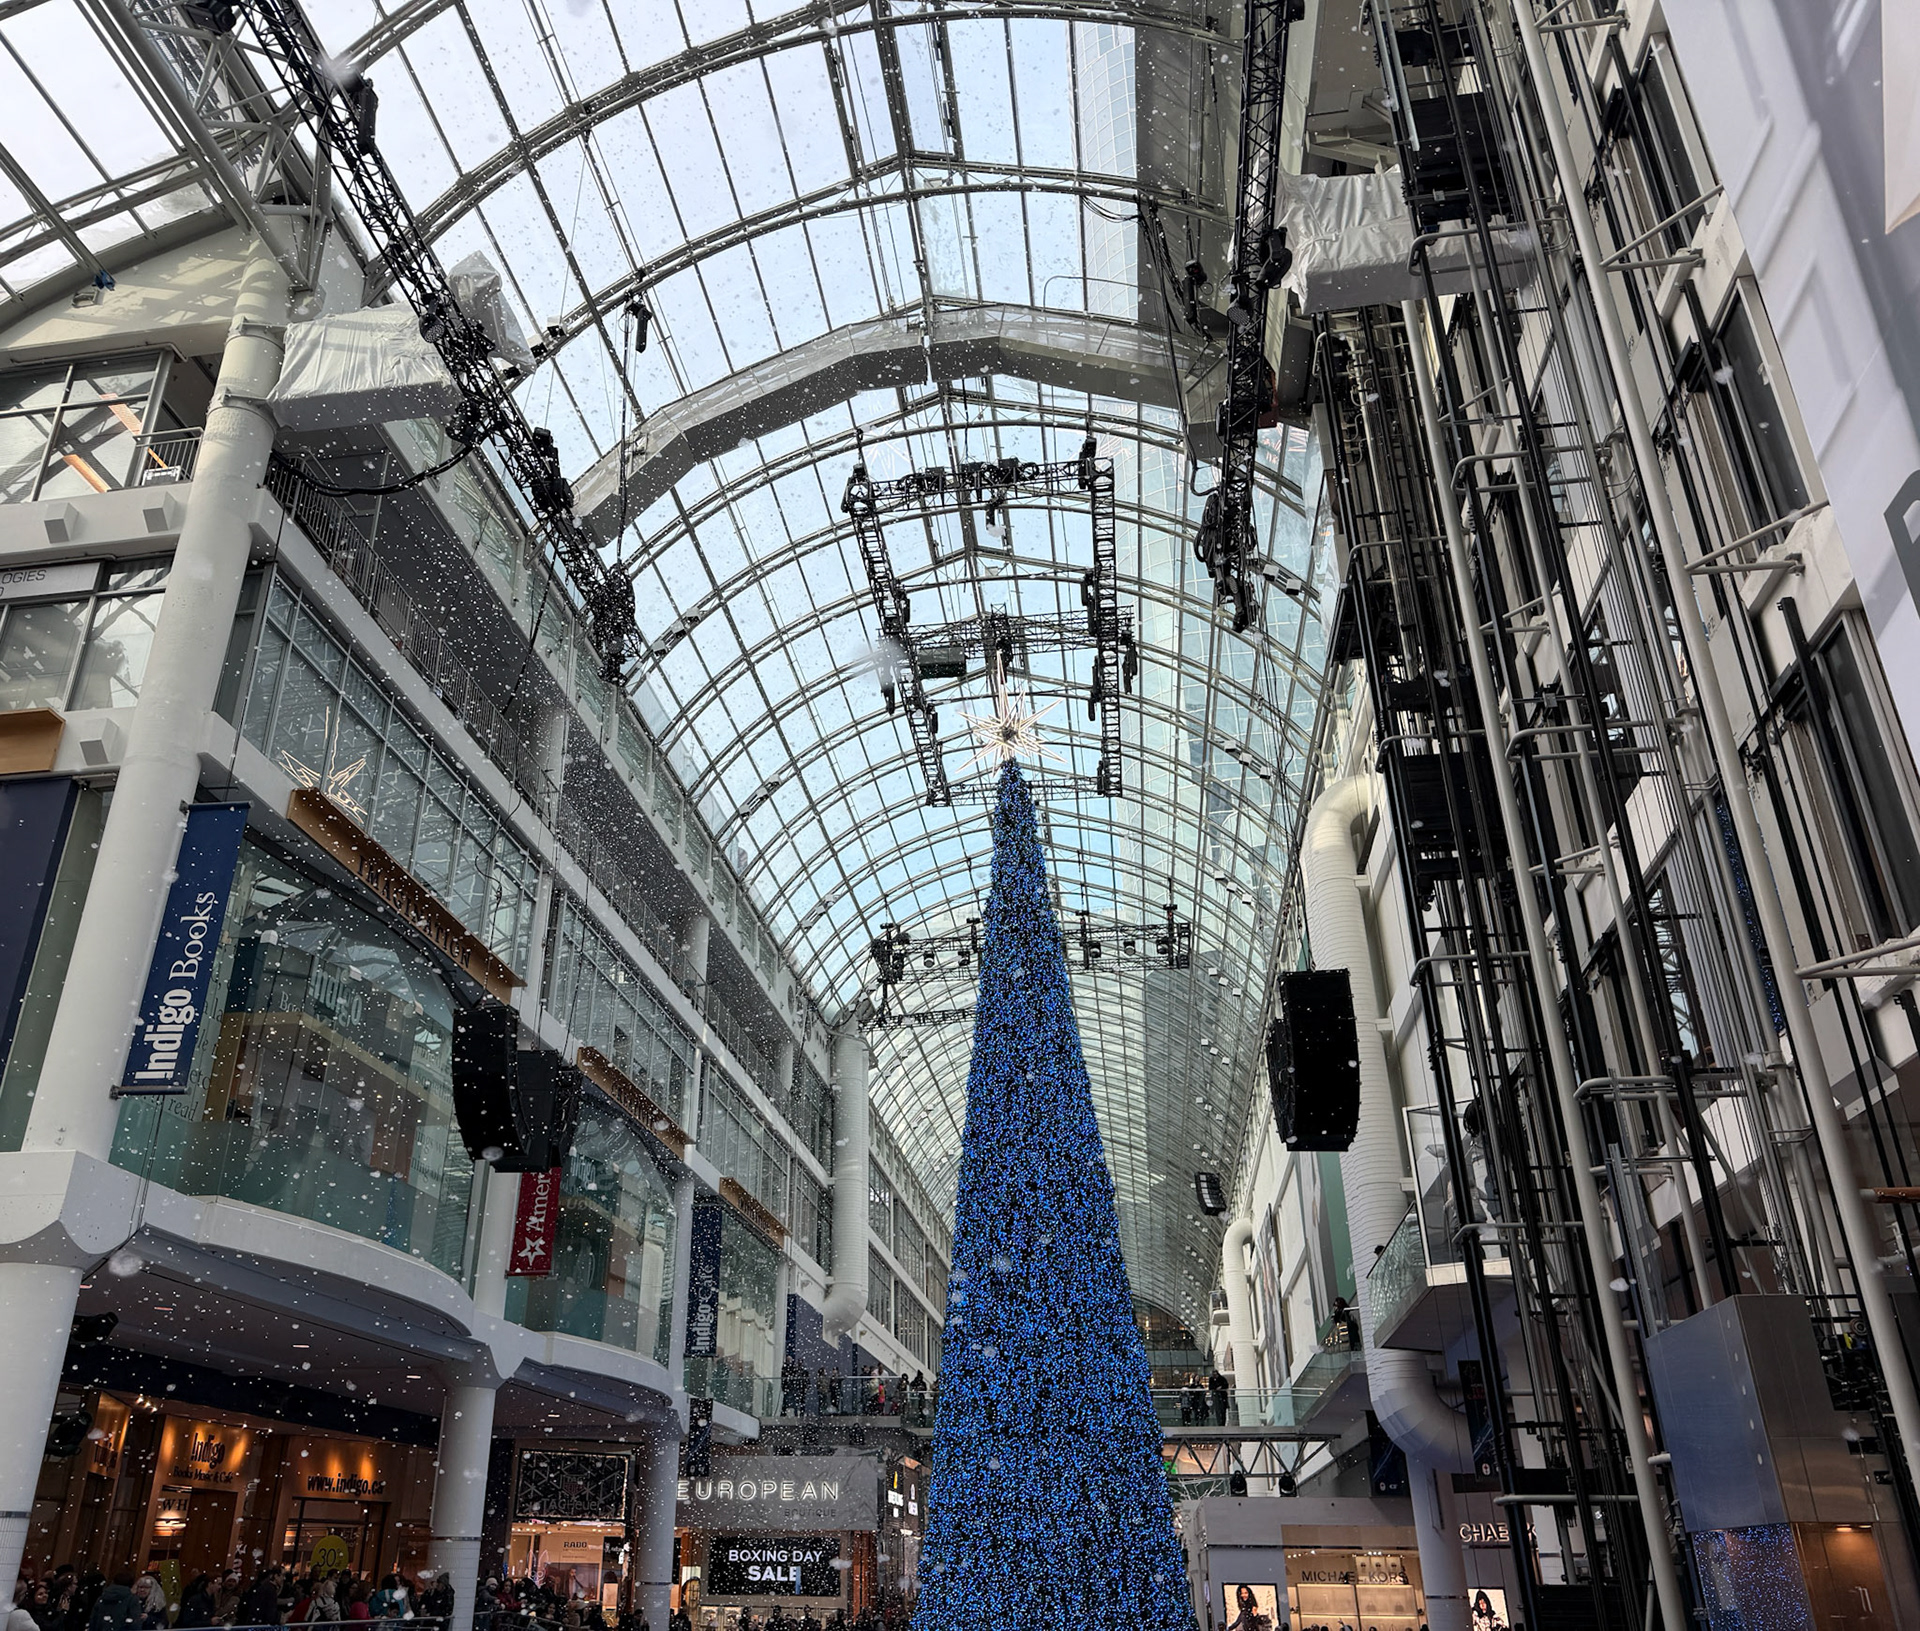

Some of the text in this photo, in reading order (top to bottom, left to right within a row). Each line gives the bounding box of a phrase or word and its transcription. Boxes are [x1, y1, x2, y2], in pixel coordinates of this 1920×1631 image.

[0, 569, 47, 585] OGIES
[357, 855, 472, 969] IMAGINATION
[134, 988, 195, 1080] Indigo
[169, 891, 217, 981] Books
[167, 1098, 199, 1122] read
[526, 1167, 553, 1233] Amer
[691, 1303, 714, 1352] Indigo
[190, 1432, 225, 1469] Indigo
[307, 1473, 384, 1496] www.indigo.ca
[677, 1480, 839, 1500] EUROPEAN
[784, 1508, 837, 1517] BOUTIQUE
[728, 1550, 823, 1562] BOXING DAY
[747, 1565, 799, 1582] SALE
[1301, 1570, 1407, 1583] MICHAEL KORS
